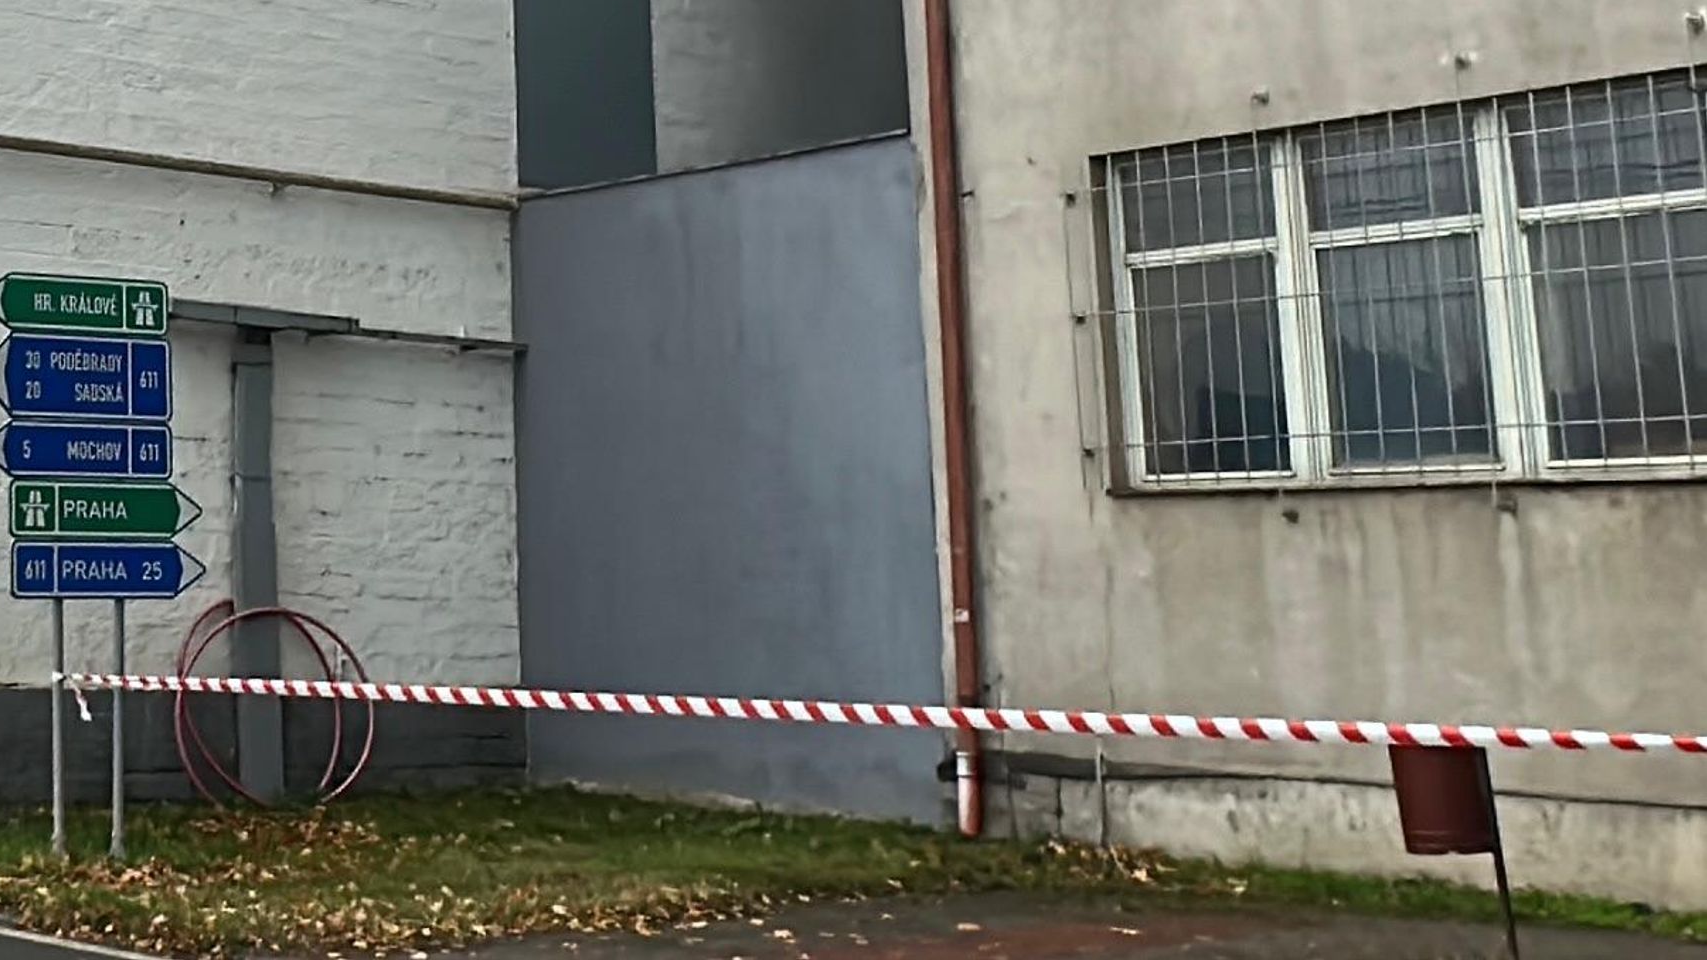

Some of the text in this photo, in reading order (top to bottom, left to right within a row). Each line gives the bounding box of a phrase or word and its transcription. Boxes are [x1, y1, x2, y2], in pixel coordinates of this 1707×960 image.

[34, 291, 118, 316] HR. KRÁLOVÉ
[25, 350, 41, 369] 30
[139, 370, 159, 389] 611
[25, 380, 124, 402] 20 SADSKÁ
[22, 439, 122, 460] 5 MOCHOV
[139, 443, 160, 461] 611
[63, 500, 127, 519] PRAHA
[25, 559, 46, 580] 611
[62, 559, 162, 580] PRAHA 25
